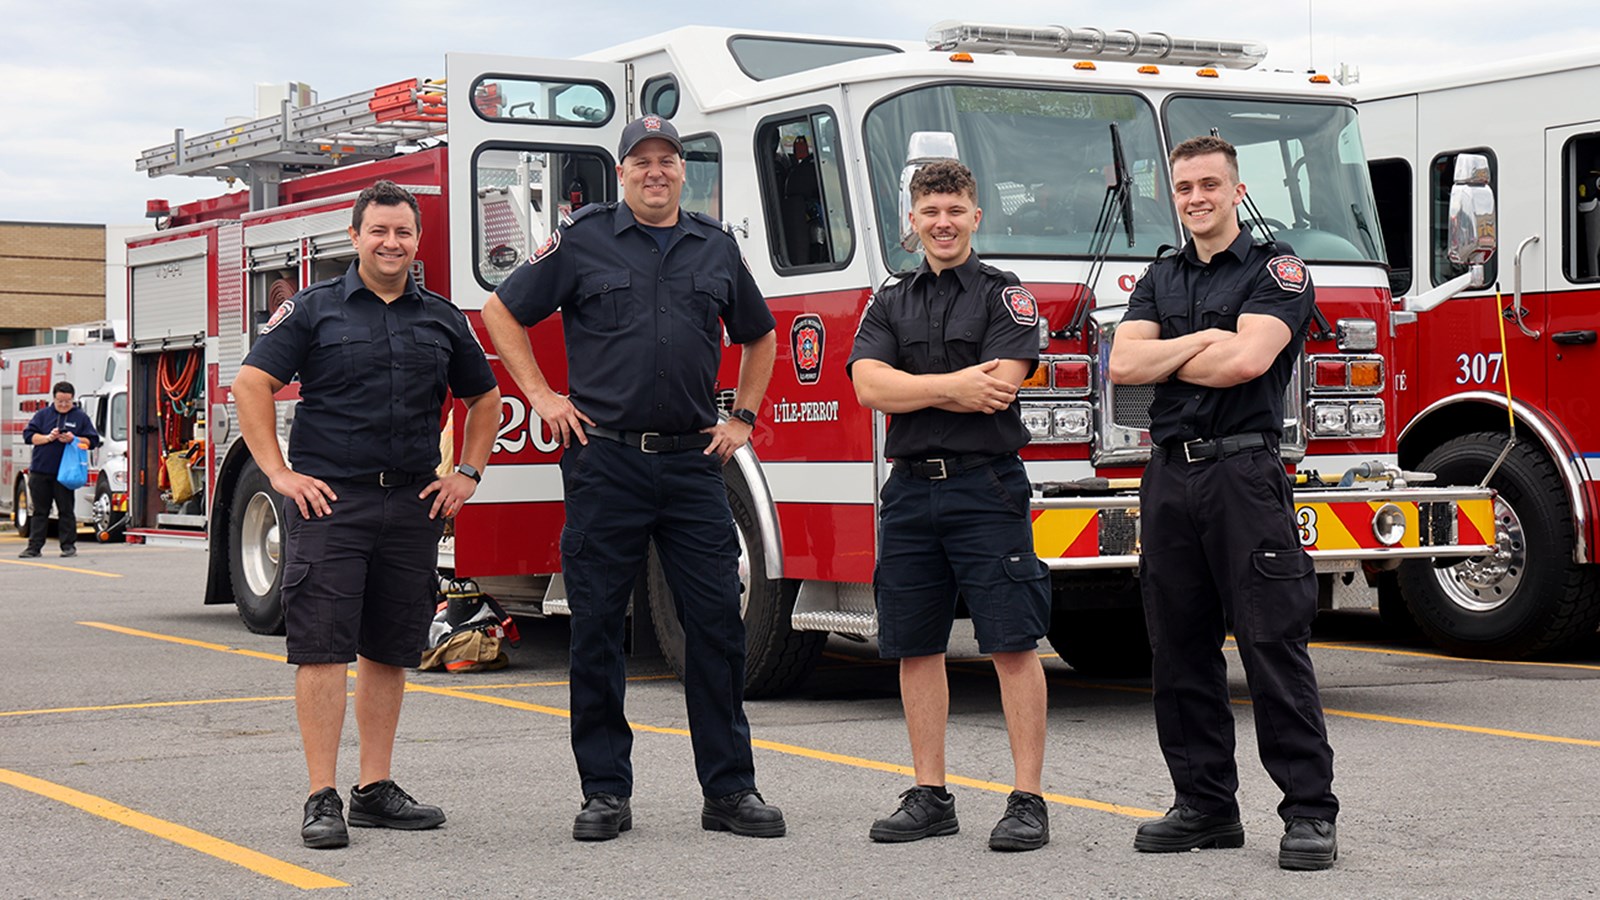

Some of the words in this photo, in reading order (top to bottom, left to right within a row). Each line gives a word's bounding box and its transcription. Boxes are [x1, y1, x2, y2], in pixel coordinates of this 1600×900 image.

[1455, 352, 1503, 385] 307
[773, 397, 839, 423] L'ÎLE-PERROT
[1297, 507, 1318, 546] 3
